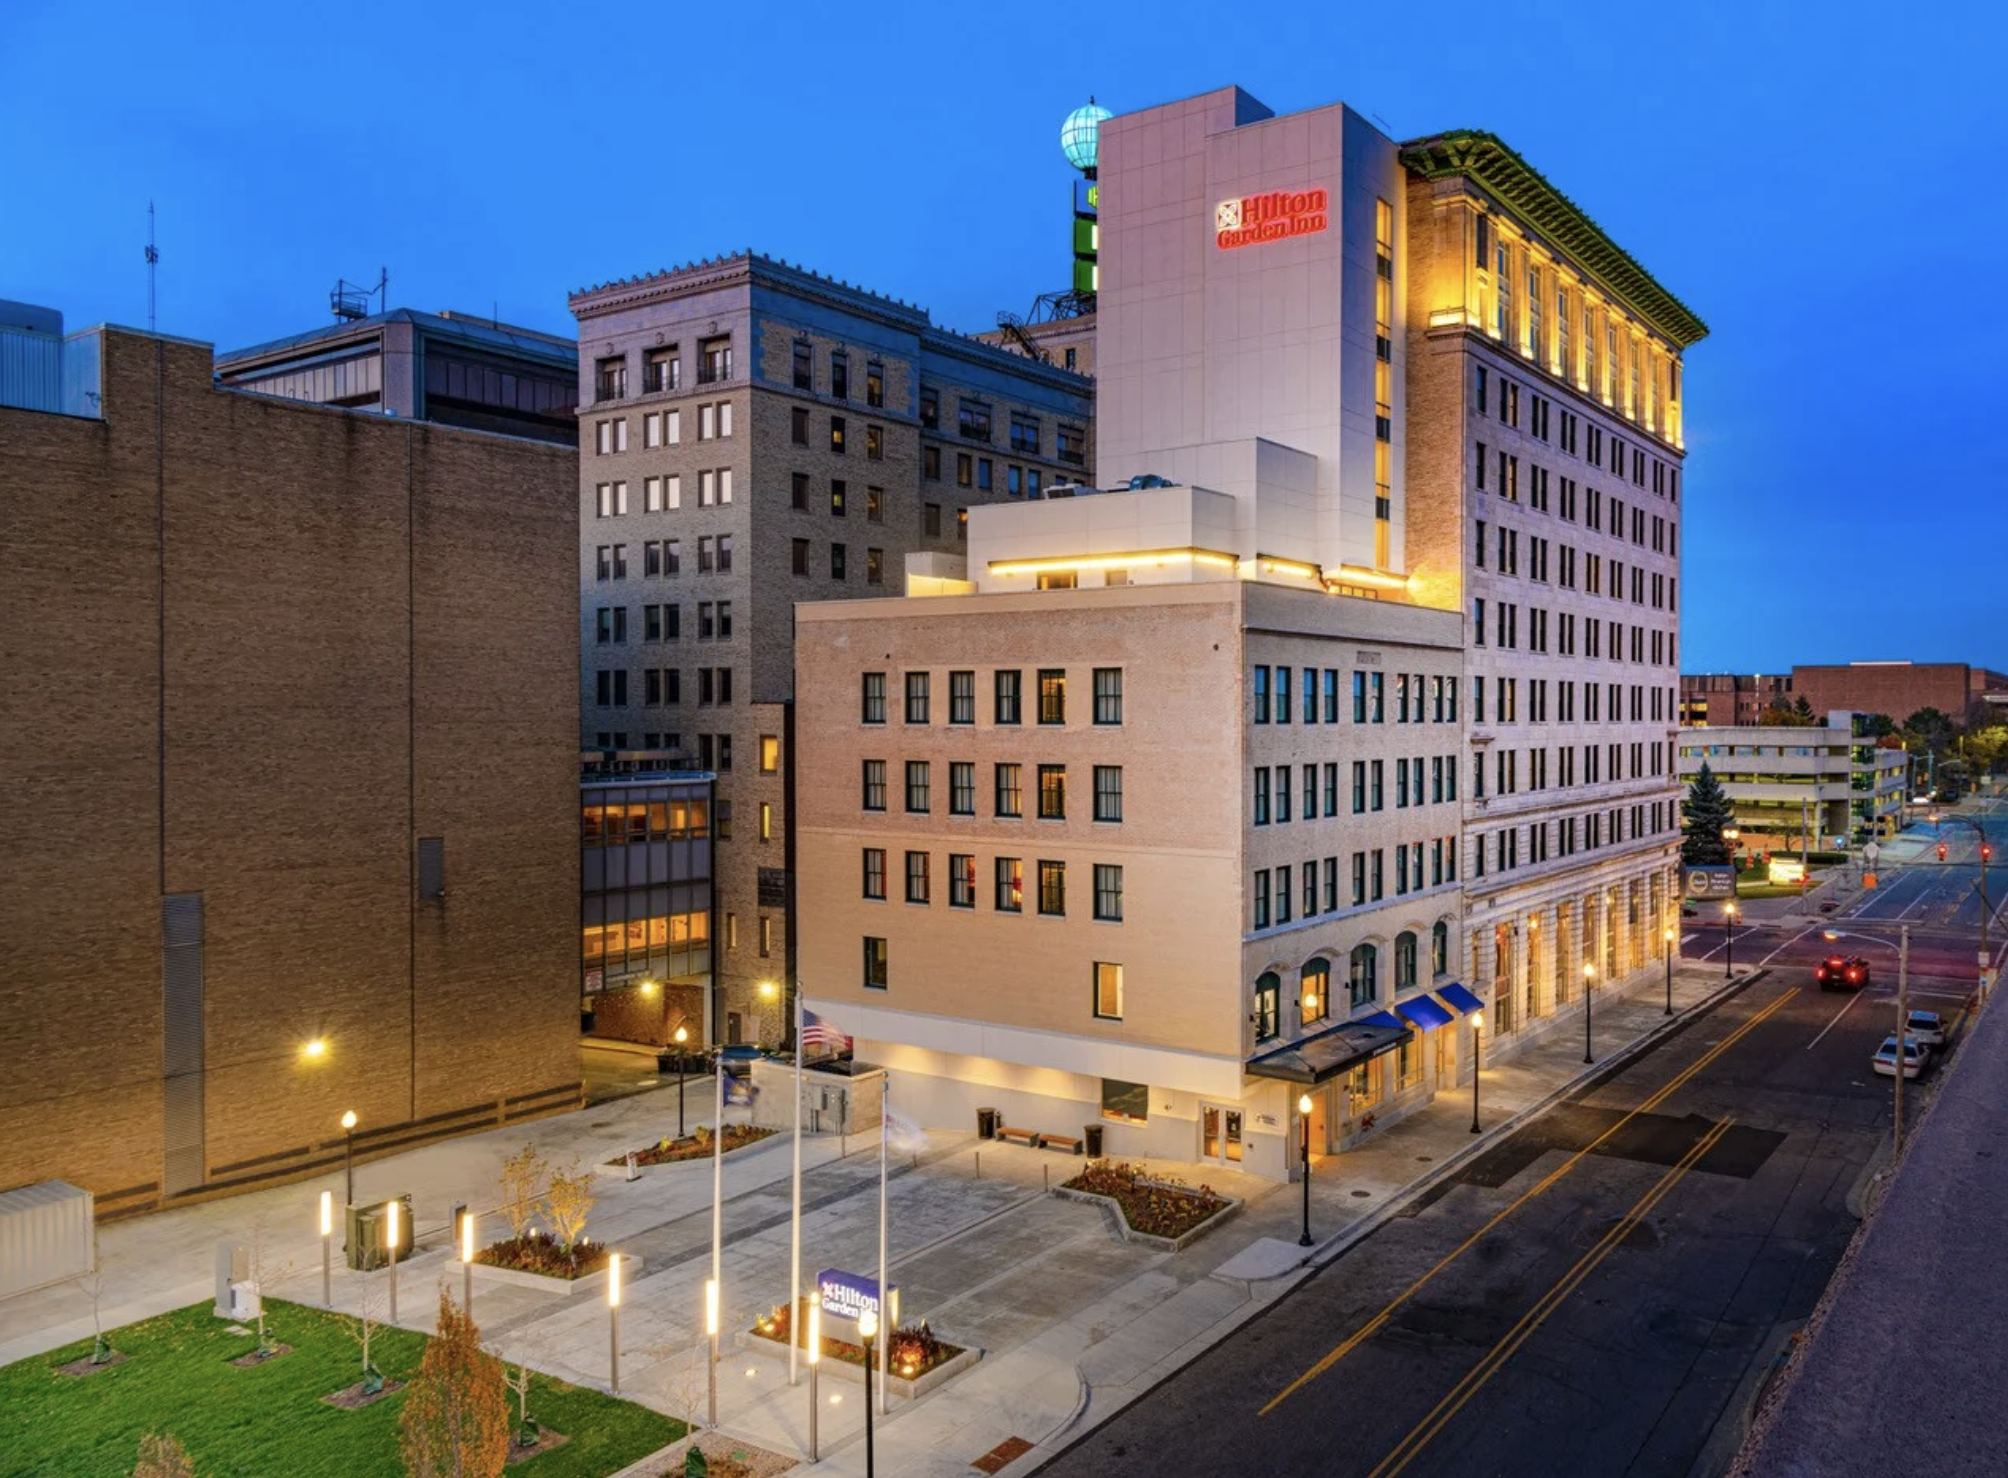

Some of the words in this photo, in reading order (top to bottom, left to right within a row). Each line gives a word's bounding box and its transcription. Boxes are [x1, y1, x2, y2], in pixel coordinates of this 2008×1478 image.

[1241, 189, 1326, 226] Hilton
[1218, 222, 1289, 248] Garden
[1290, 214, 1326, 235] Inn
[822, 1297, 859, 1318] Garden
[834, 1283, 878, 1312] Hilton
